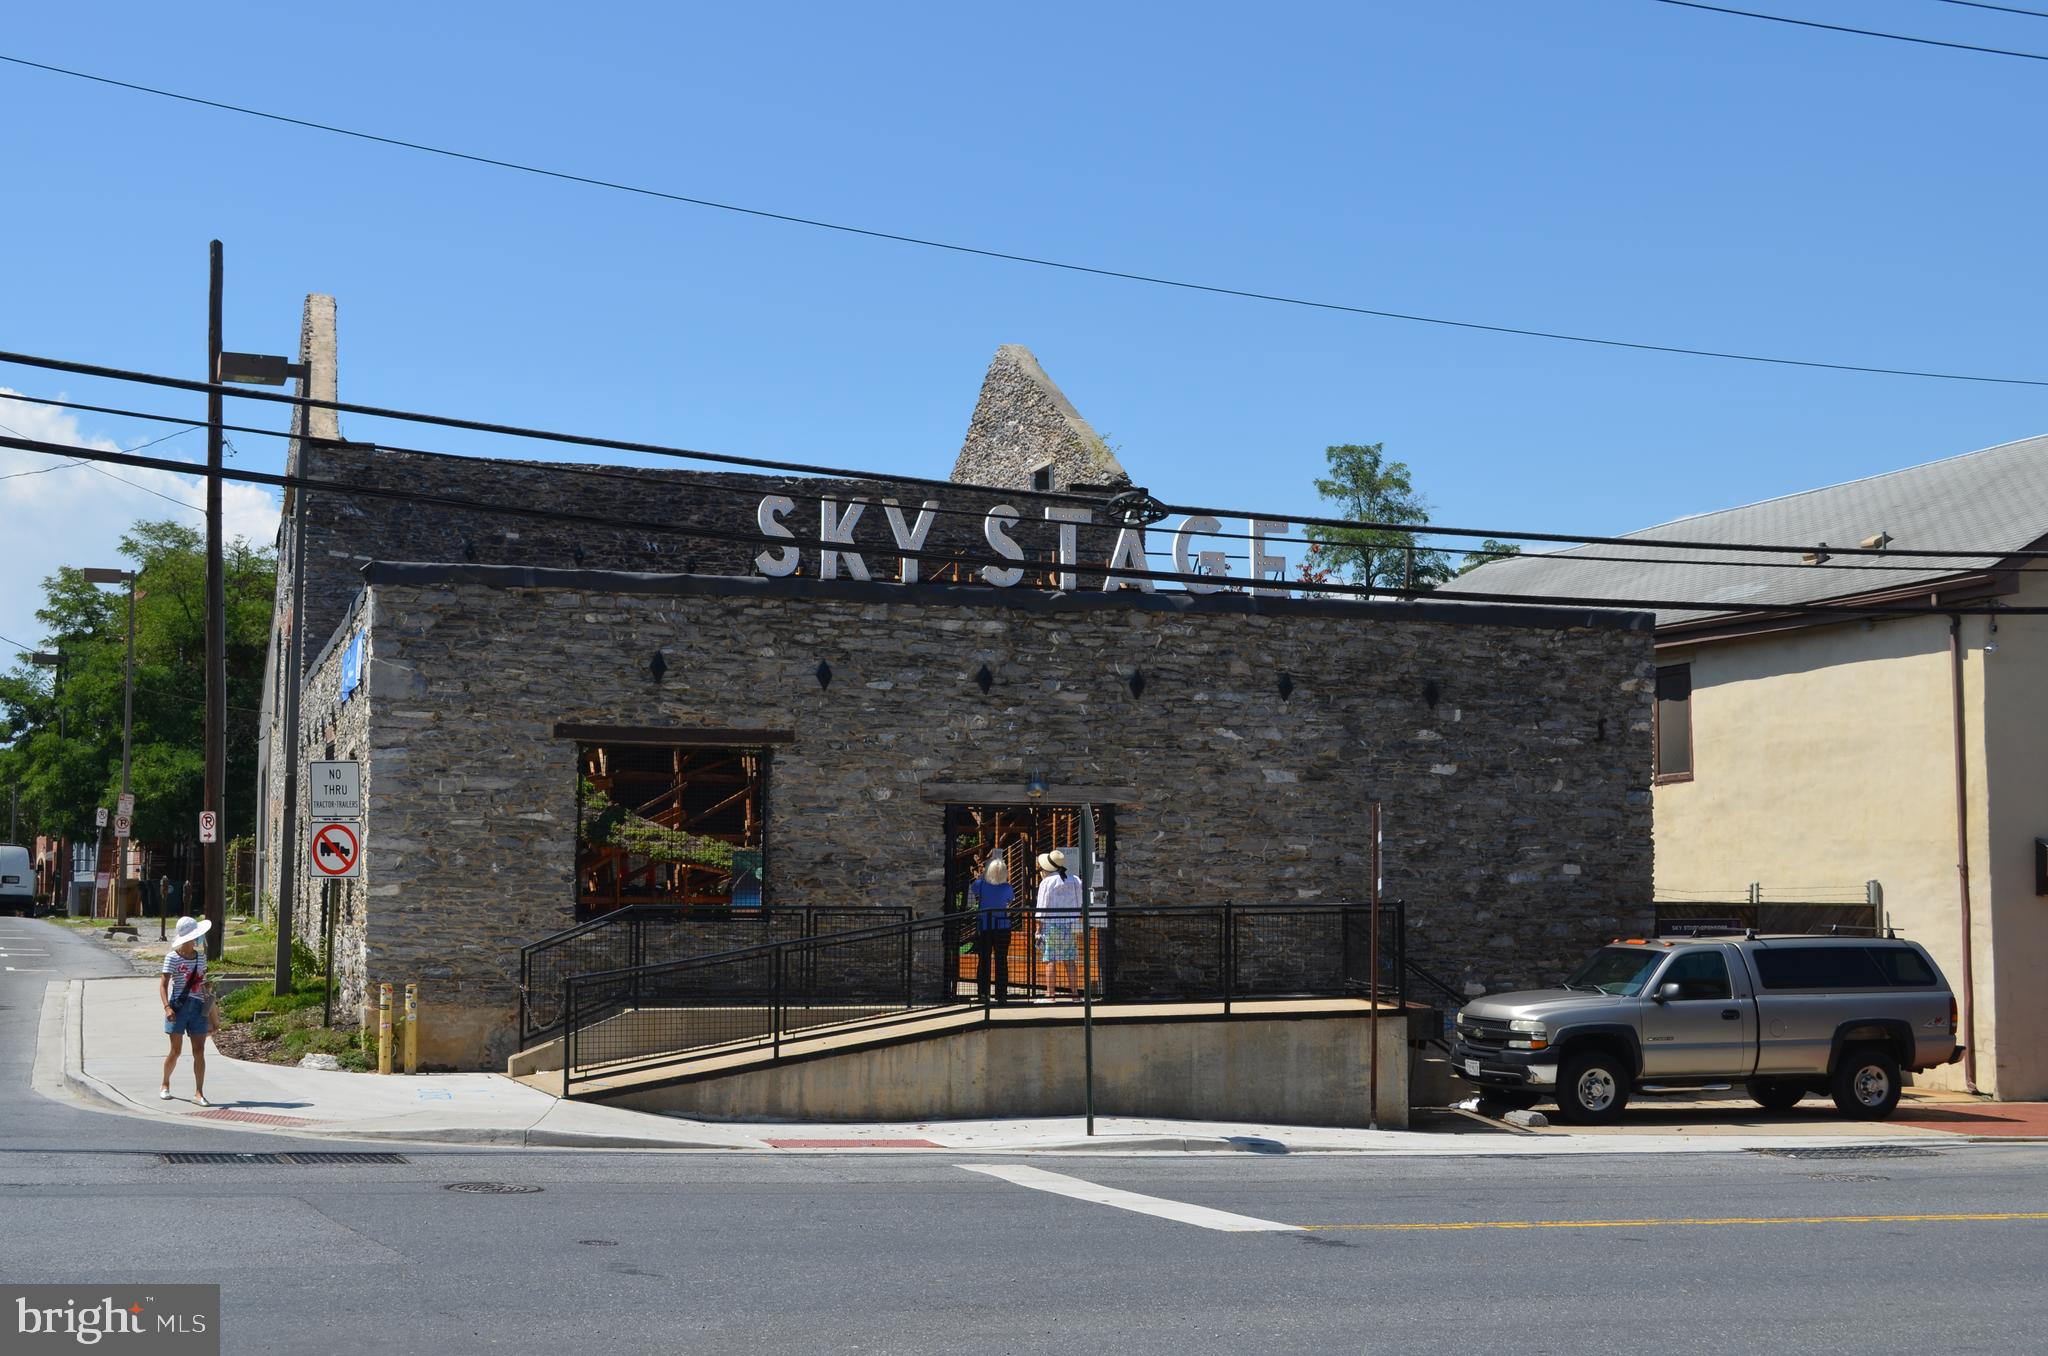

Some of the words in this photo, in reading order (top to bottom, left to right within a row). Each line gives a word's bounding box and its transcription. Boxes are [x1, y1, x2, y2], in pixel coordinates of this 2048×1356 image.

[755, 495, 940, 584] SKY
[982, 504, 1291, 598] STAGE
[329, 768, 342, 780] NO
[323, 784, 348, 796] THRU
[313, 800, 359, 809] TRACTOR-TRAILERS
